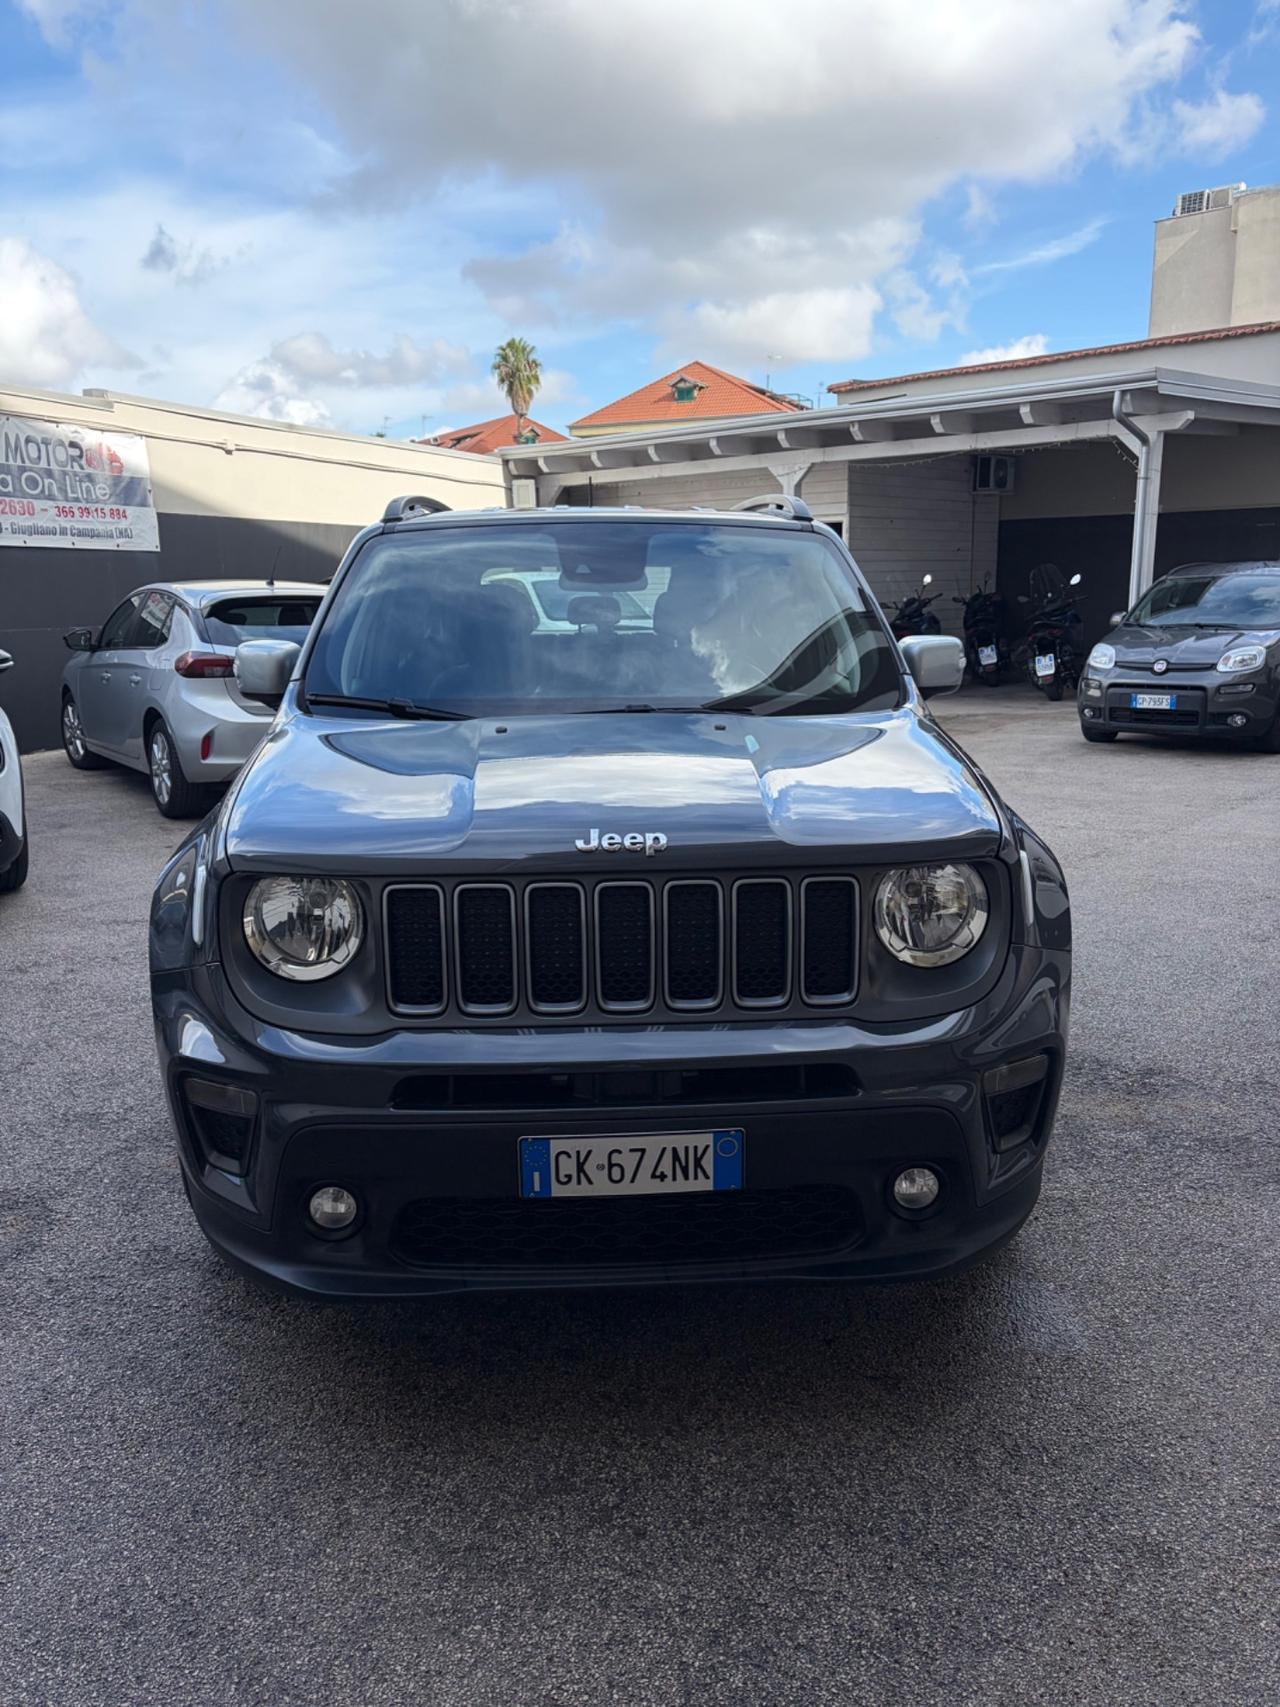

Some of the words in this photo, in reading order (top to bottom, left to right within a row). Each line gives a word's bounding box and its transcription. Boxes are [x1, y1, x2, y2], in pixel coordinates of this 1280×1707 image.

[4, 431, 85, 470] MOTOR
[21, 471, 58, 496] On
[66, 473, 110, 500] Line
[54, 505, 75, 518] 366
[10, 521, 57, 537] Giugliano
[59, 524, 68, 536] in
[70, 525, 114, 539] Campania
[575, 828, 668, 857] Jeep
